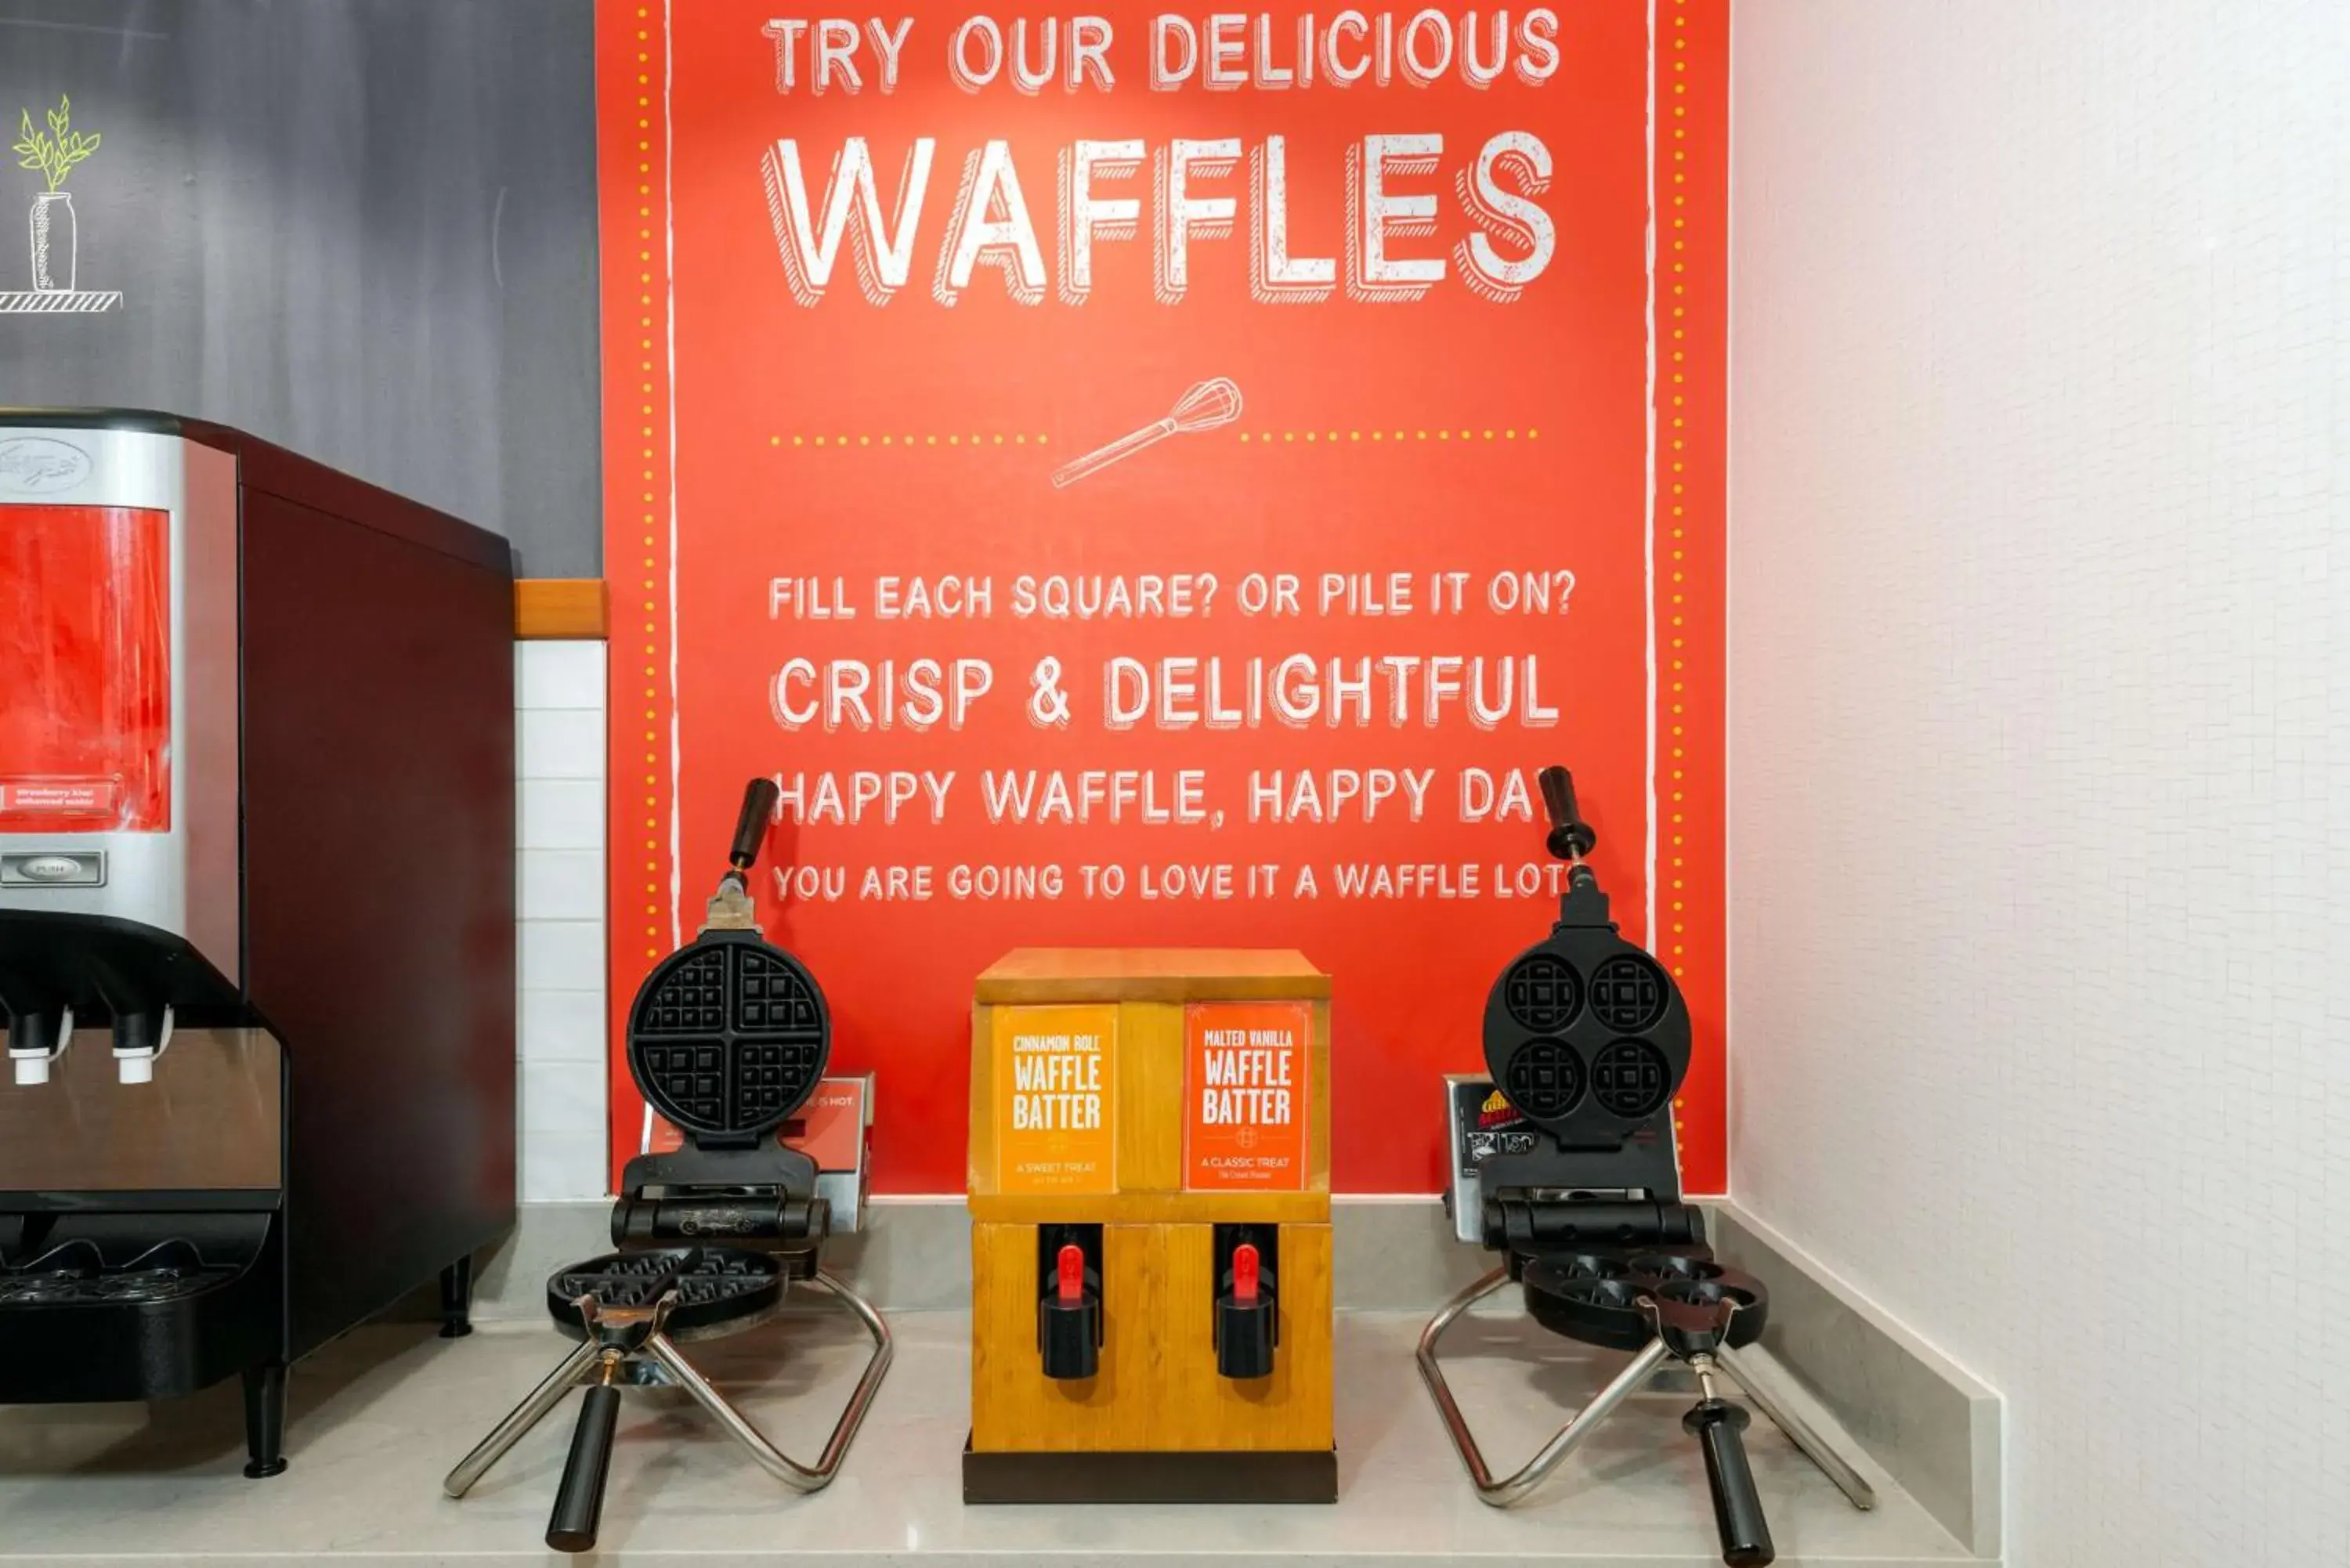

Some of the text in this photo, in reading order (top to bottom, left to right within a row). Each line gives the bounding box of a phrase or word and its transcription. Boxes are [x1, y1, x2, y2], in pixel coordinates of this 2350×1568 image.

[761, 8, 1561, 96] TRY OUR DELICIOUS
[761, 130, 1556, 308] WAFFLES
[769, 570, 1575, 619] FILL EACH SQUARE? OR PILE IT ON?
[769, 653, 1559, 733] CRISP & DELIGHTFUL
[771, 767, 1549, 832] HAPPY WAFFLE, HAPPY DA
[772, 865, 845, 901] YOU
[860, 865, 933, 901] ARE
[948, 864, 1063, 901] GOING
[1082, 864, 1125, 900] TO
[1141, 864, 1234, 900] LOVE
[1248, 864, 1280, 899] IT
[1294, 864, 1318, 899] A
[1333, 863, 1480, 899] WAFFLE
[1013, 1034, 1101, 1052] CINNAMON ROLL
[1204, 1028, 1292, 1047] MALTED VANILLA
[1014, 1054, 1102, 1091] WAFFLE
[1204, 1049, 1292, 1086] WAFFLE
[1013, 1093, 1101, 1129] BATTER
[1202, 1087, 1291, 1125] BATTER
[1015, 1162, 1096, 1173] A SWEET TREAT
[1201, 1156, 1290, 1168] A CLASSIC TREAT
